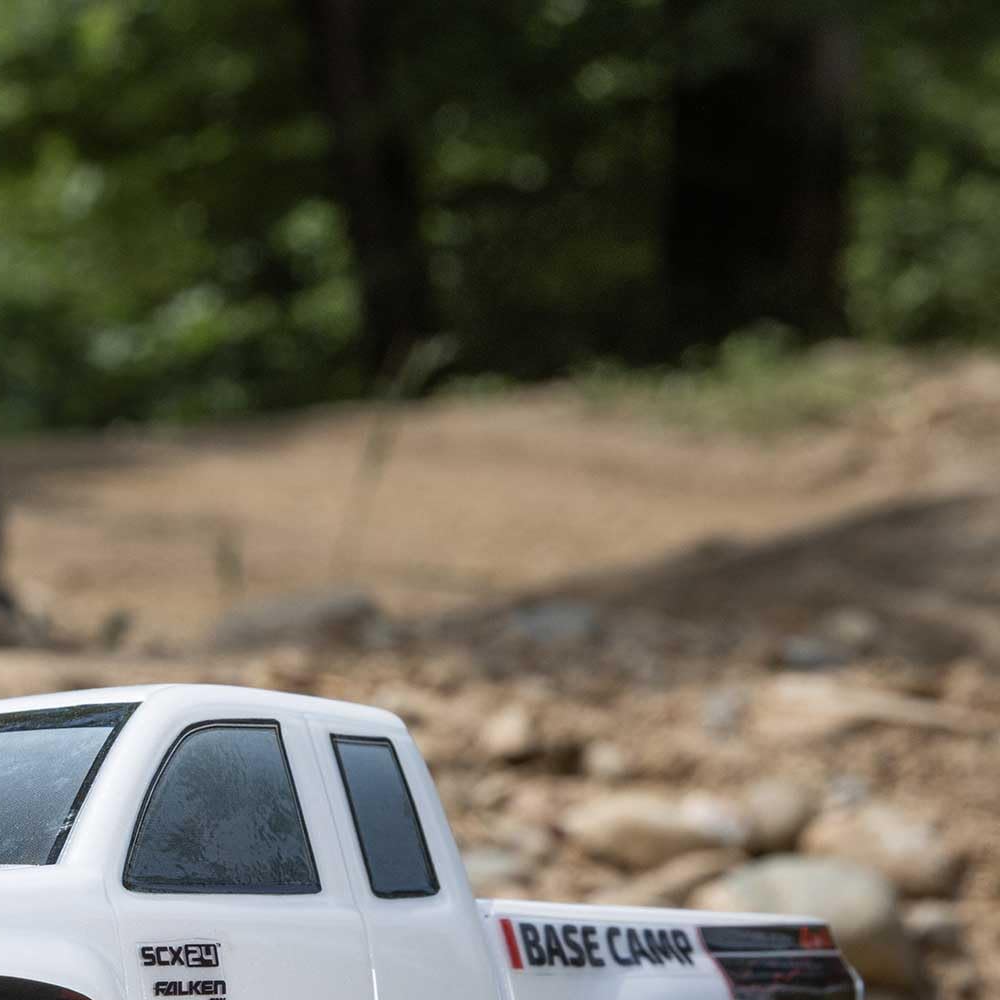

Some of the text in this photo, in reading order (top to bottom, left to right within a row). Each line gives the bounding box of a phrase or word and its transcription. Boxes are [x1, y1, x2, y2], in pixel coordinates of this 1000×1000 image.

[518, 922, 697, 968] BASE CAMP
[154, 980, 227, 997] FALKEN
